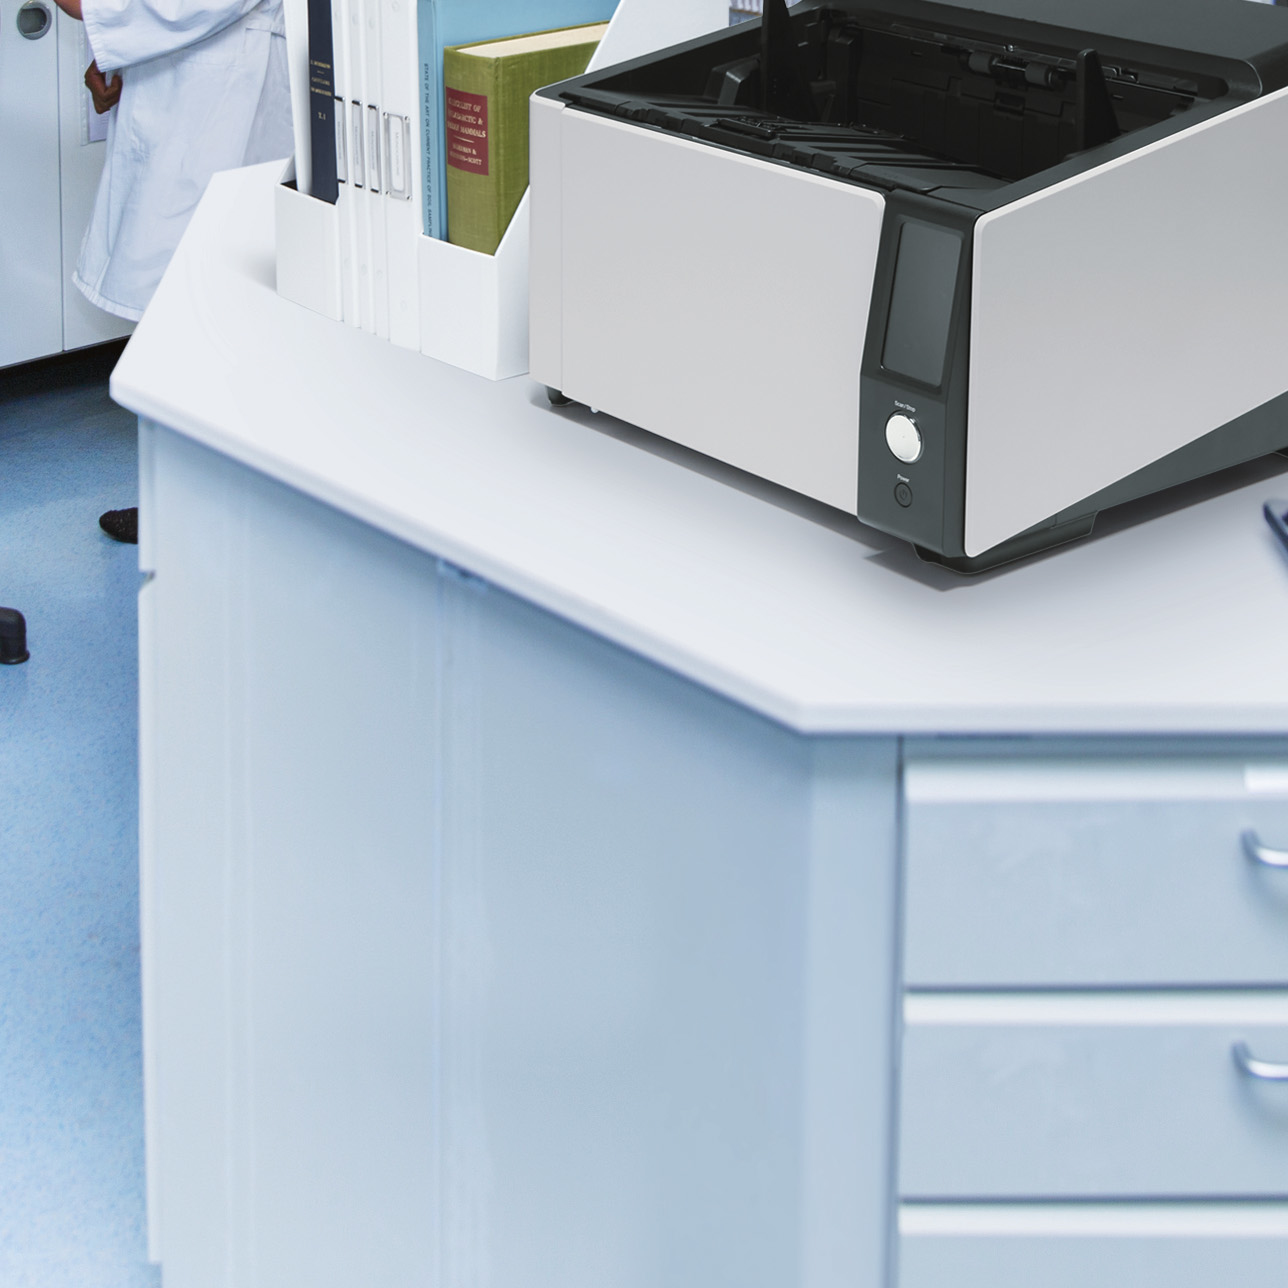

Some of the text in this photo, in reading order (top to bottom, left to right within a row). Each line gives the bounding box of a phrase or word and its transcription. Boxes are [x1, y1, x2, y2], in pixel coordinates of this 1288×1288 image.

[424, 82, 430, 91] OF
[473, 104, 482, 113] OF
[425, 118, 430, 127] ON
[427, 184, 432, 193] OF
[894, 400, 916, 413] Scan/Stop
